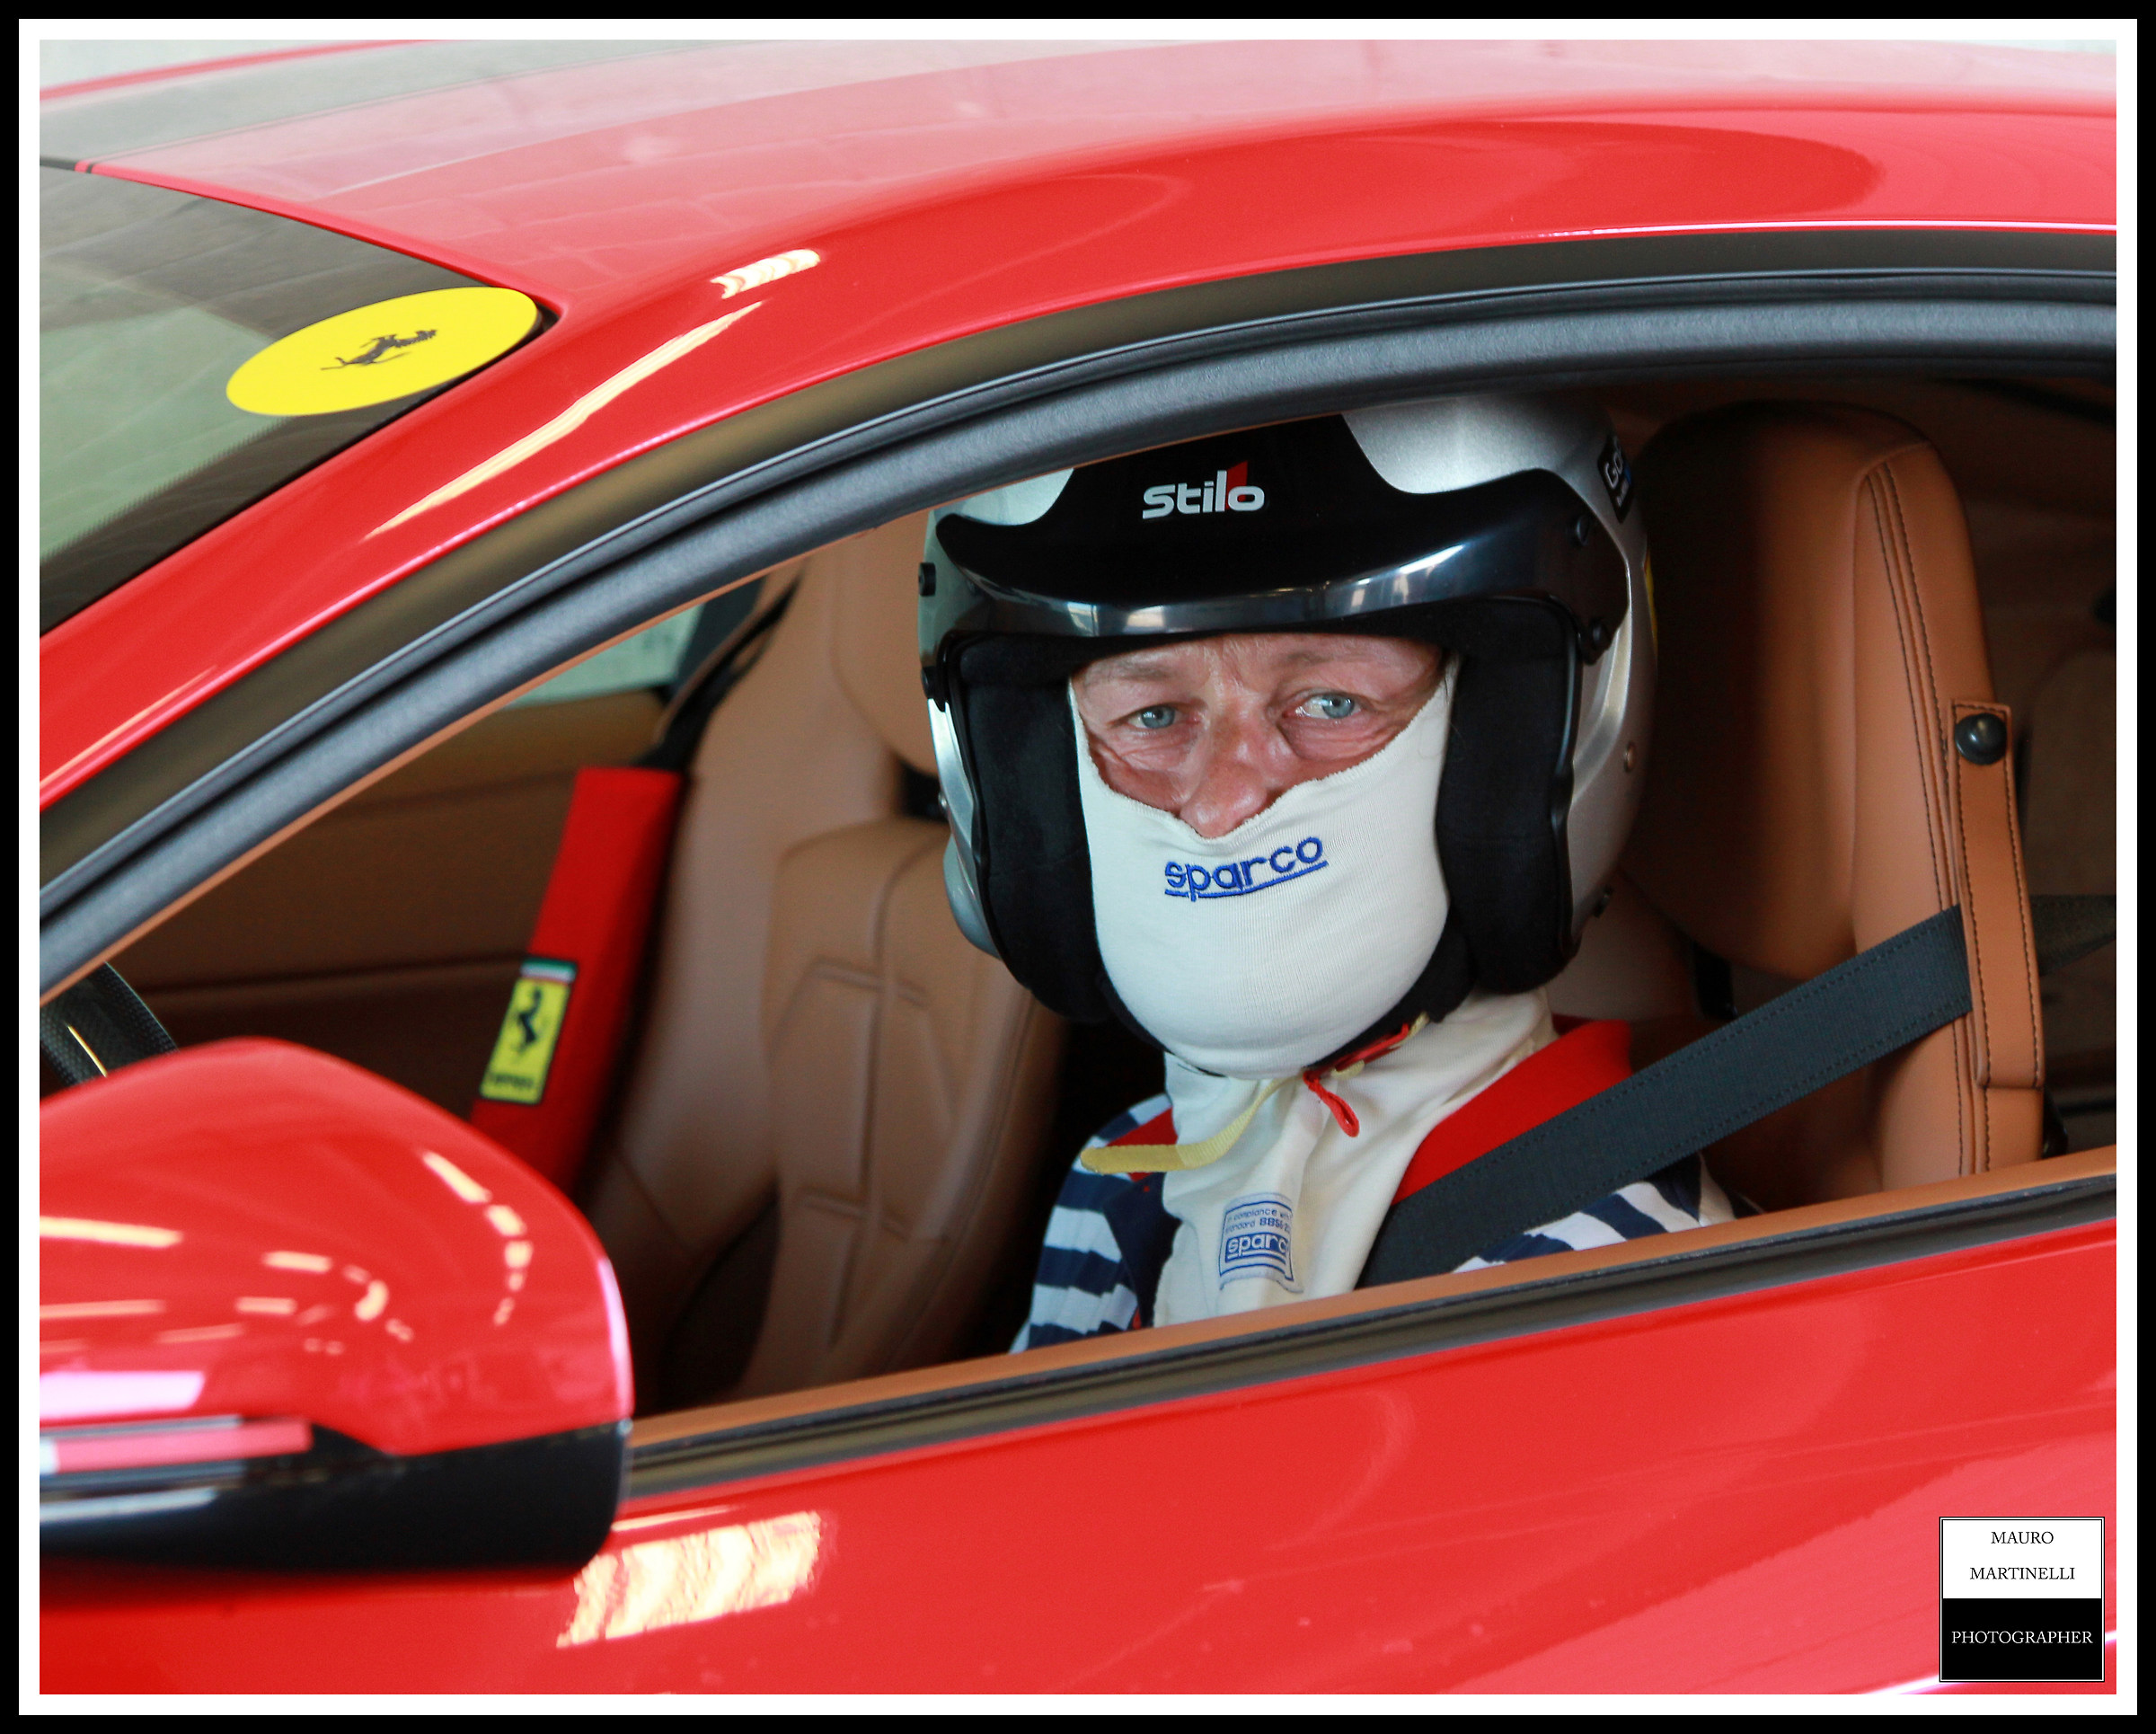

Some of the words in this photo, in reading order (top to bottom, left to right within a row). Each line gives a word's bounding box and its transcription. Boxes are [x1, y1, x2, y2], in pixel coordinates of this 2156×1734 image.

[1142, 469, 1265, 519] stilo
[1164, 836, 1324, 902] sparco
[1233, 1208, 1277, 1221] compliance
[1227, 1234, 1287, 1257] sparc
